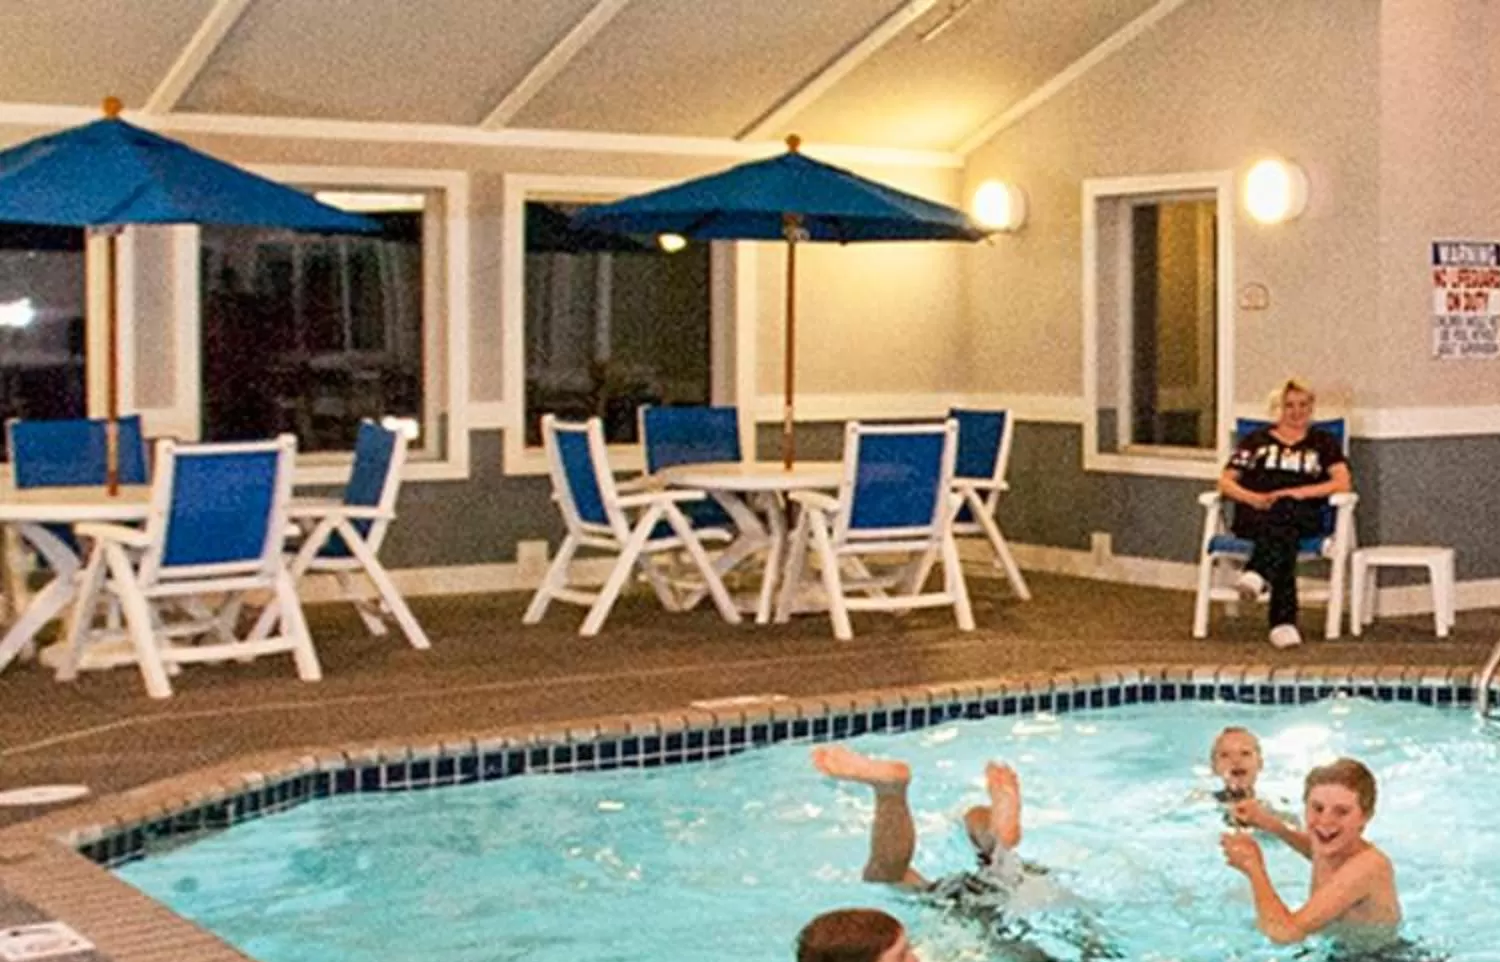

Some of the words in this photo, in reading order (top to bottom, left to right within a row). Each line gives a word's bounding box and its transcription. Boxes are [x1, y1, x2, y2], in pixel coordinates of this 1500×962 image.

[1438, 244, 1499, 263] WARNING
[1433, 269, 1447, 288] NO
[1447, 292, 1460, 311] ON
[1464, 292, 1489, 311] DUTY
